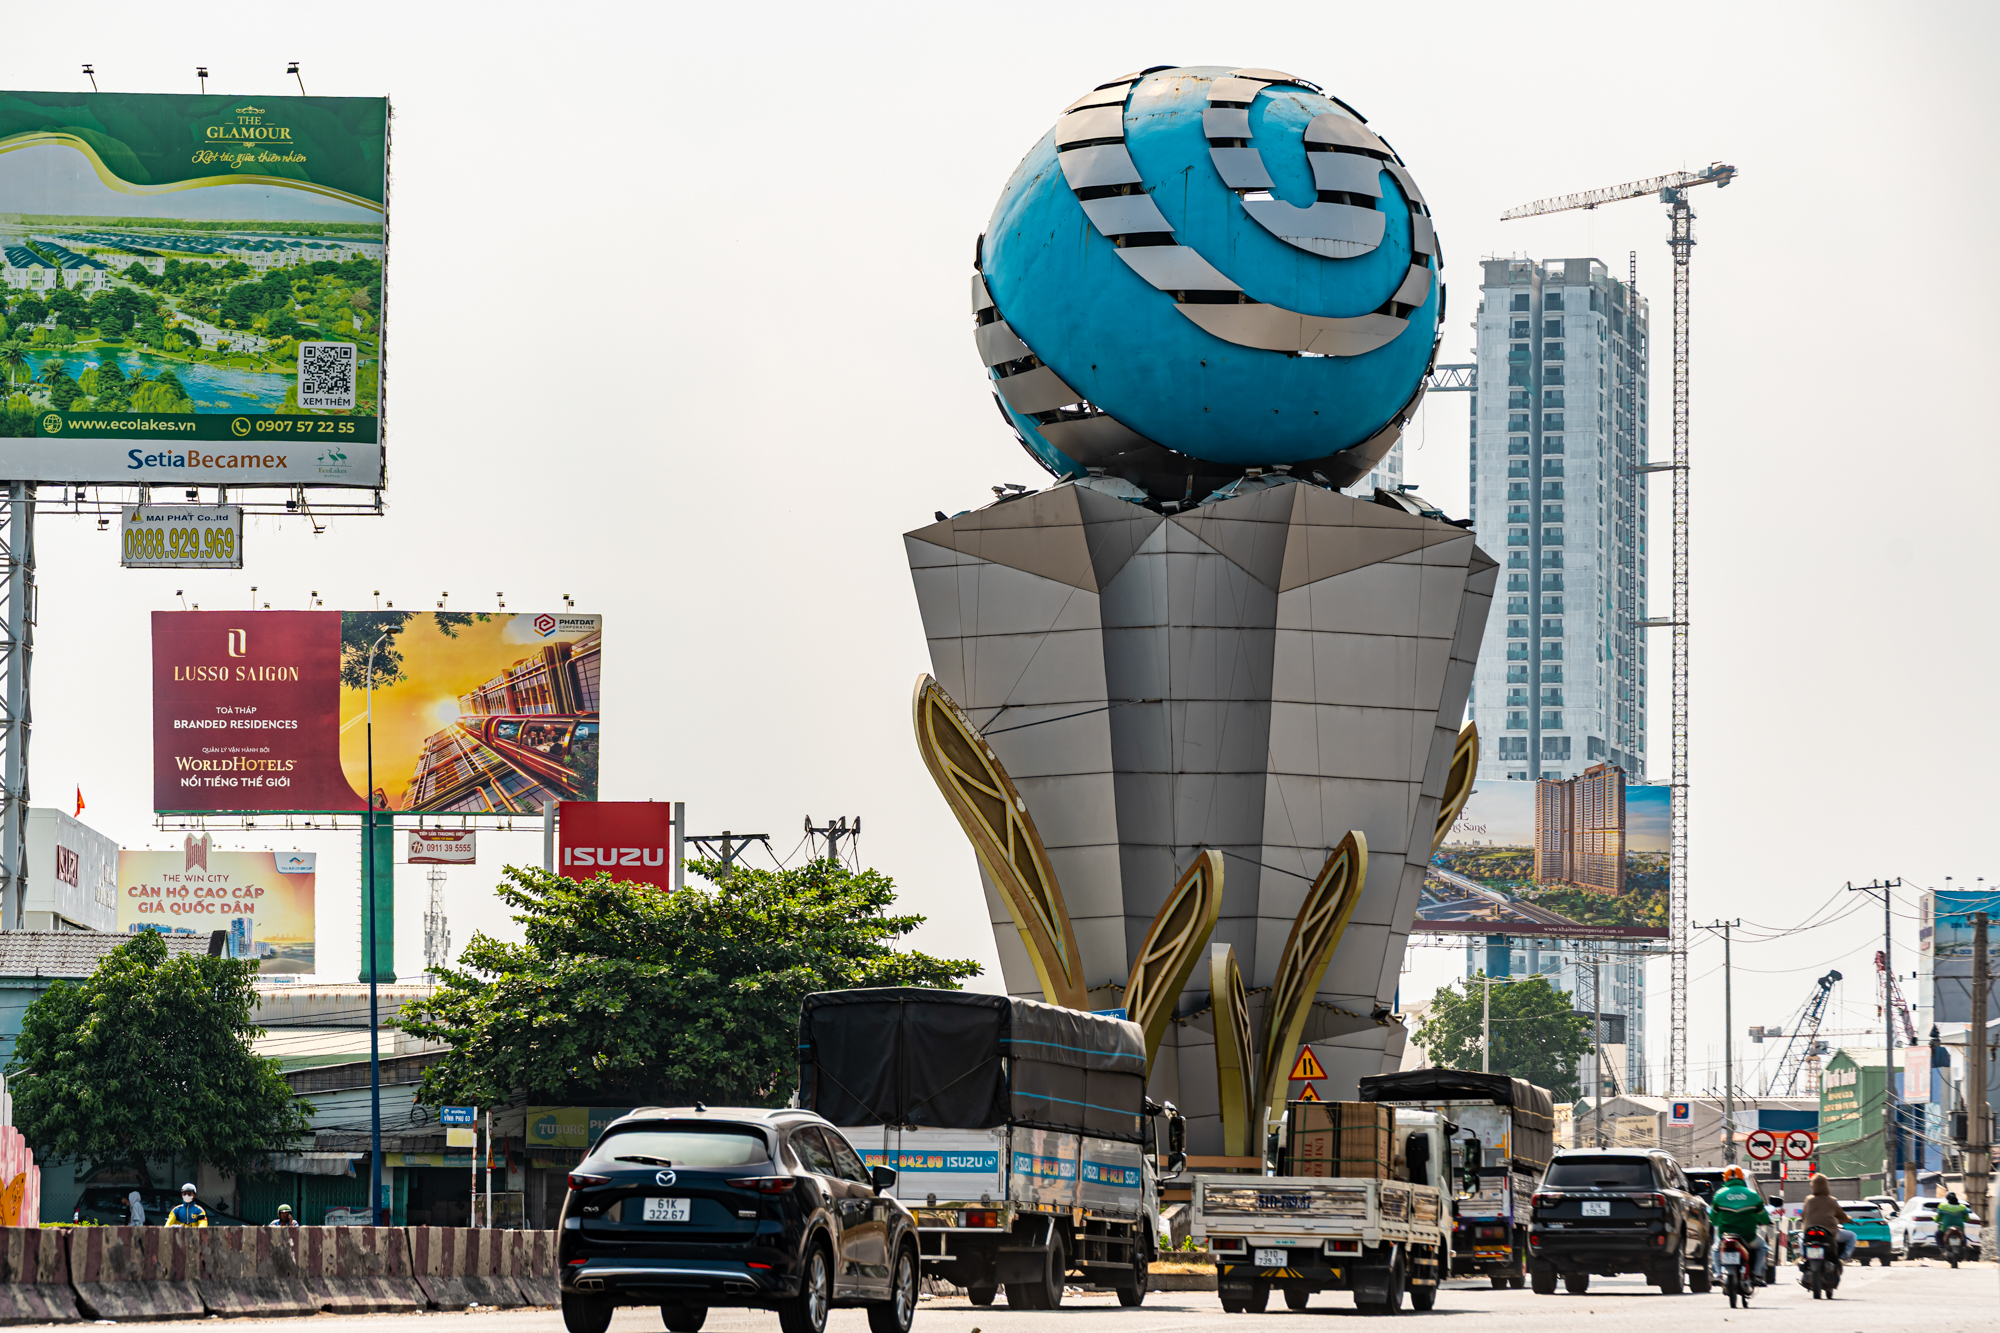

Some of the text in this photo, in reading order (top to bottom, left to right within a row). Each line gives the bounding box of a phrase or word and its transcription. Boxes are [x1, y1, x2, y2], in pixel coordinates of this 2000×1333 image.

[237, 116, 262, 125] THE
[206, 126, 292, 139] GLAMOUR
[219, 151, 235, 162] tác
[257, 150, 281, 163] thiên
[282, 150, 307, 163] nhiên
[303, 396, 351, 407] XEM THÊM
[67, 418, 197, 432] www.ecolakes.vn
[255, 420, 355, 434] 0907 57 22 55
[127, 448, 288, 470] SetiaBecamex
[124, 527, 235, 560] 0888.929.969
[174, 665, 299, 682] LUSSO SAIGON
[216, 705, 257, 715] TOÀ THÁP
[173, 719, 298, 730] BRANDED RESIDENCES
[204, 774, 239, 787] TIẾNG
[241, 774, 263, 787] THẾ
[265, 775, 291, 787] GIỚI
[1463, 822, 1487, 835] Sang
[426, 843, 472, 853] 0911 39 5555
[564, 847, 664, 866] ISUZU
[163, 873, 230, 883] THE WIN CITY
[127, 884, 162, 898] CĂN
[166, 884, 190, 901] HỘ
[193, 886, 228, 899] CAO
[231, 884, 265, 899] CẤP
[137, 899, 255, 916] GIÁ QUỐC DÂN
[539, 1123, 585, 1136] TUBORG
[899, 1155, 944, 1168] 042.09
[947, 1156, 983, 1168] ISUZU
[657, 1198, 677, 1209] 61K
[649, 1209, 685, 1220] 322.67
[1264, 1250, 1279, 1258] 51D
[1258, 1257, 1284, 1266] 739.37
